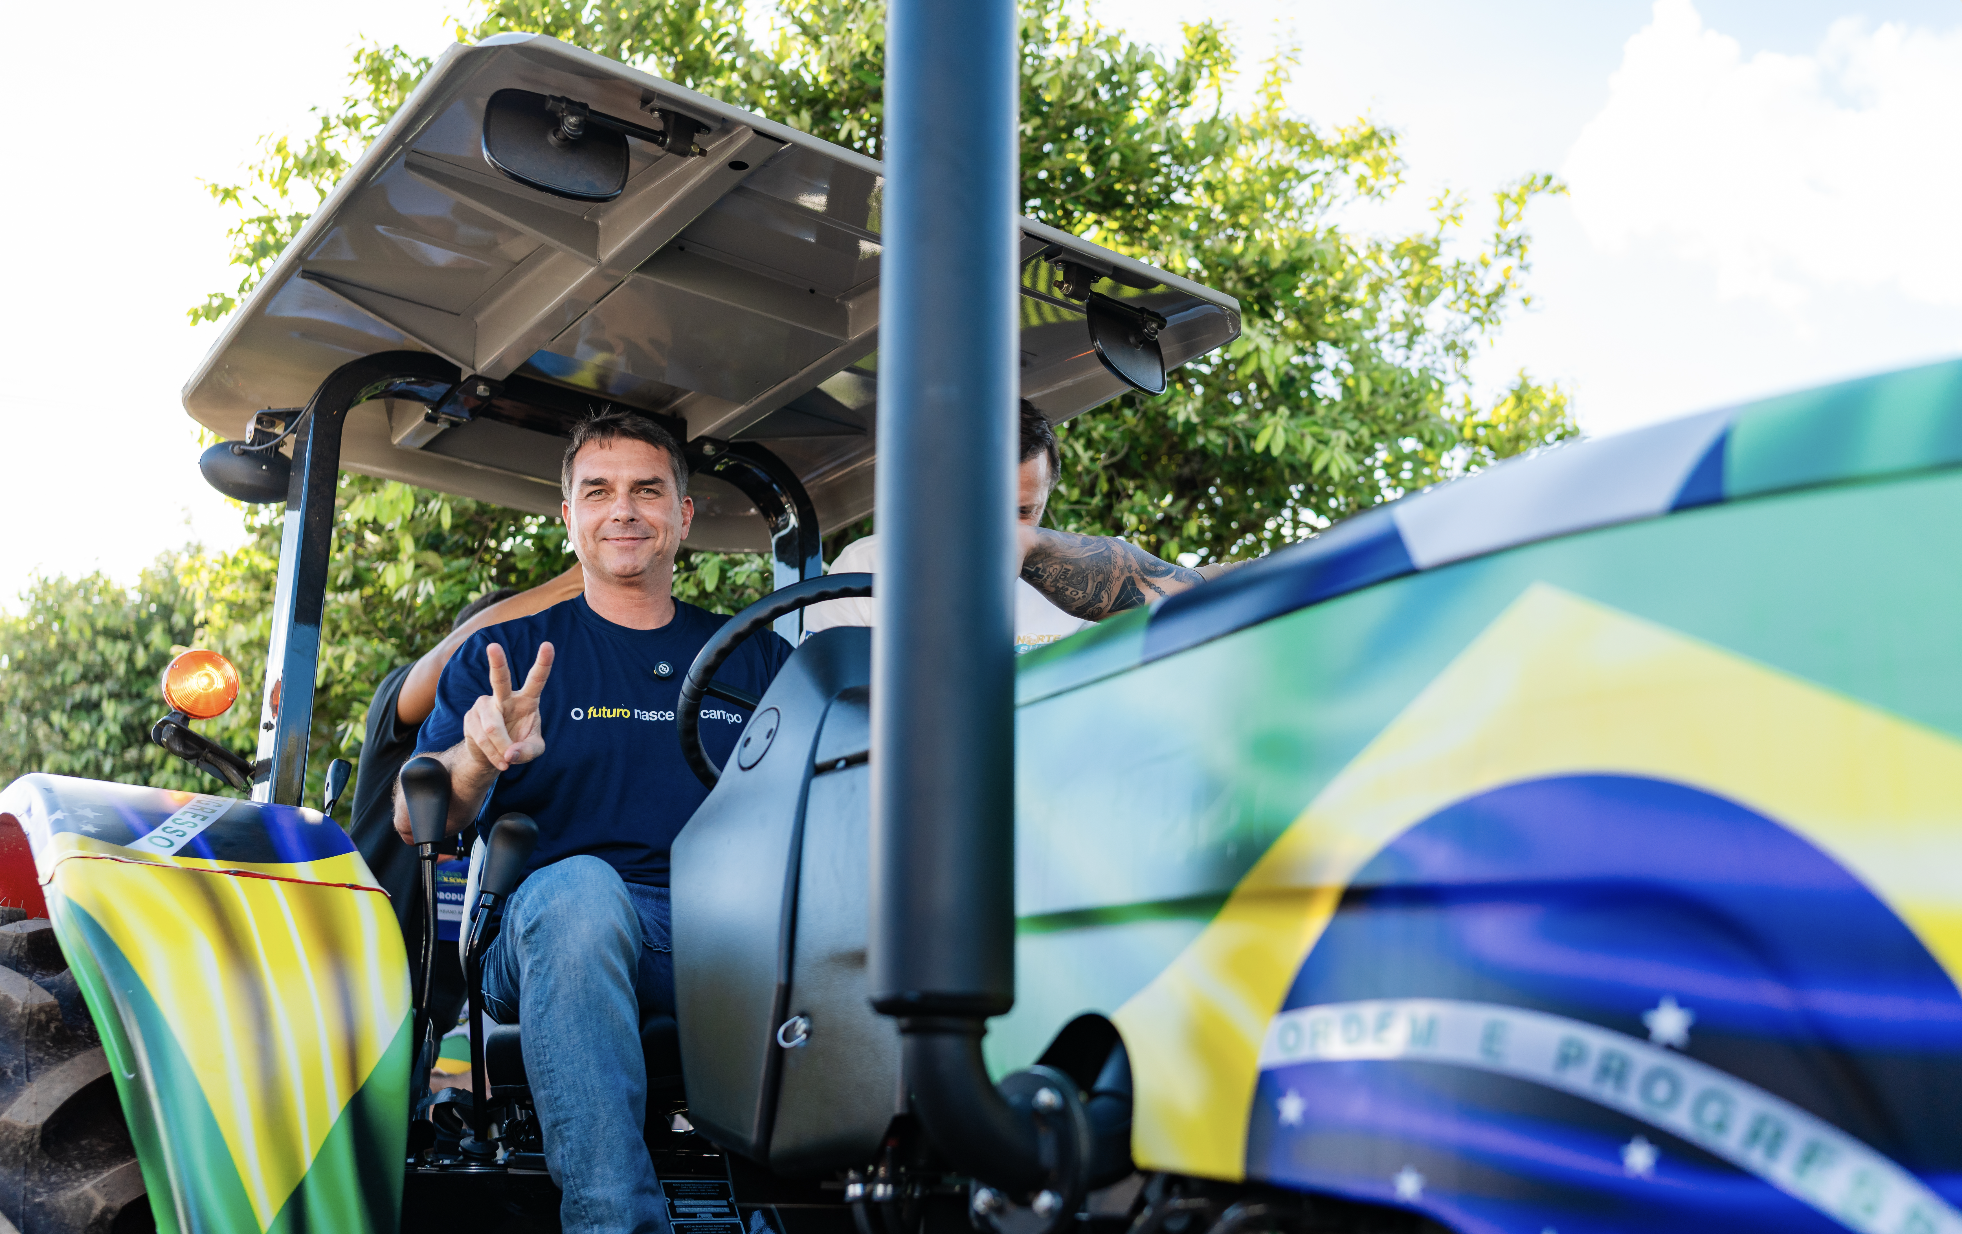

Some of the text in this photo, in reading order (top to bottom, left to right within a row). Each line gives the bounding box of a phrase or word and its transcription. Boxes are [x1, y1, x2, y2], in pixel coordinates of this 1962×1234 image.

[571, 706, 743, 725] O futuro nasce campo
